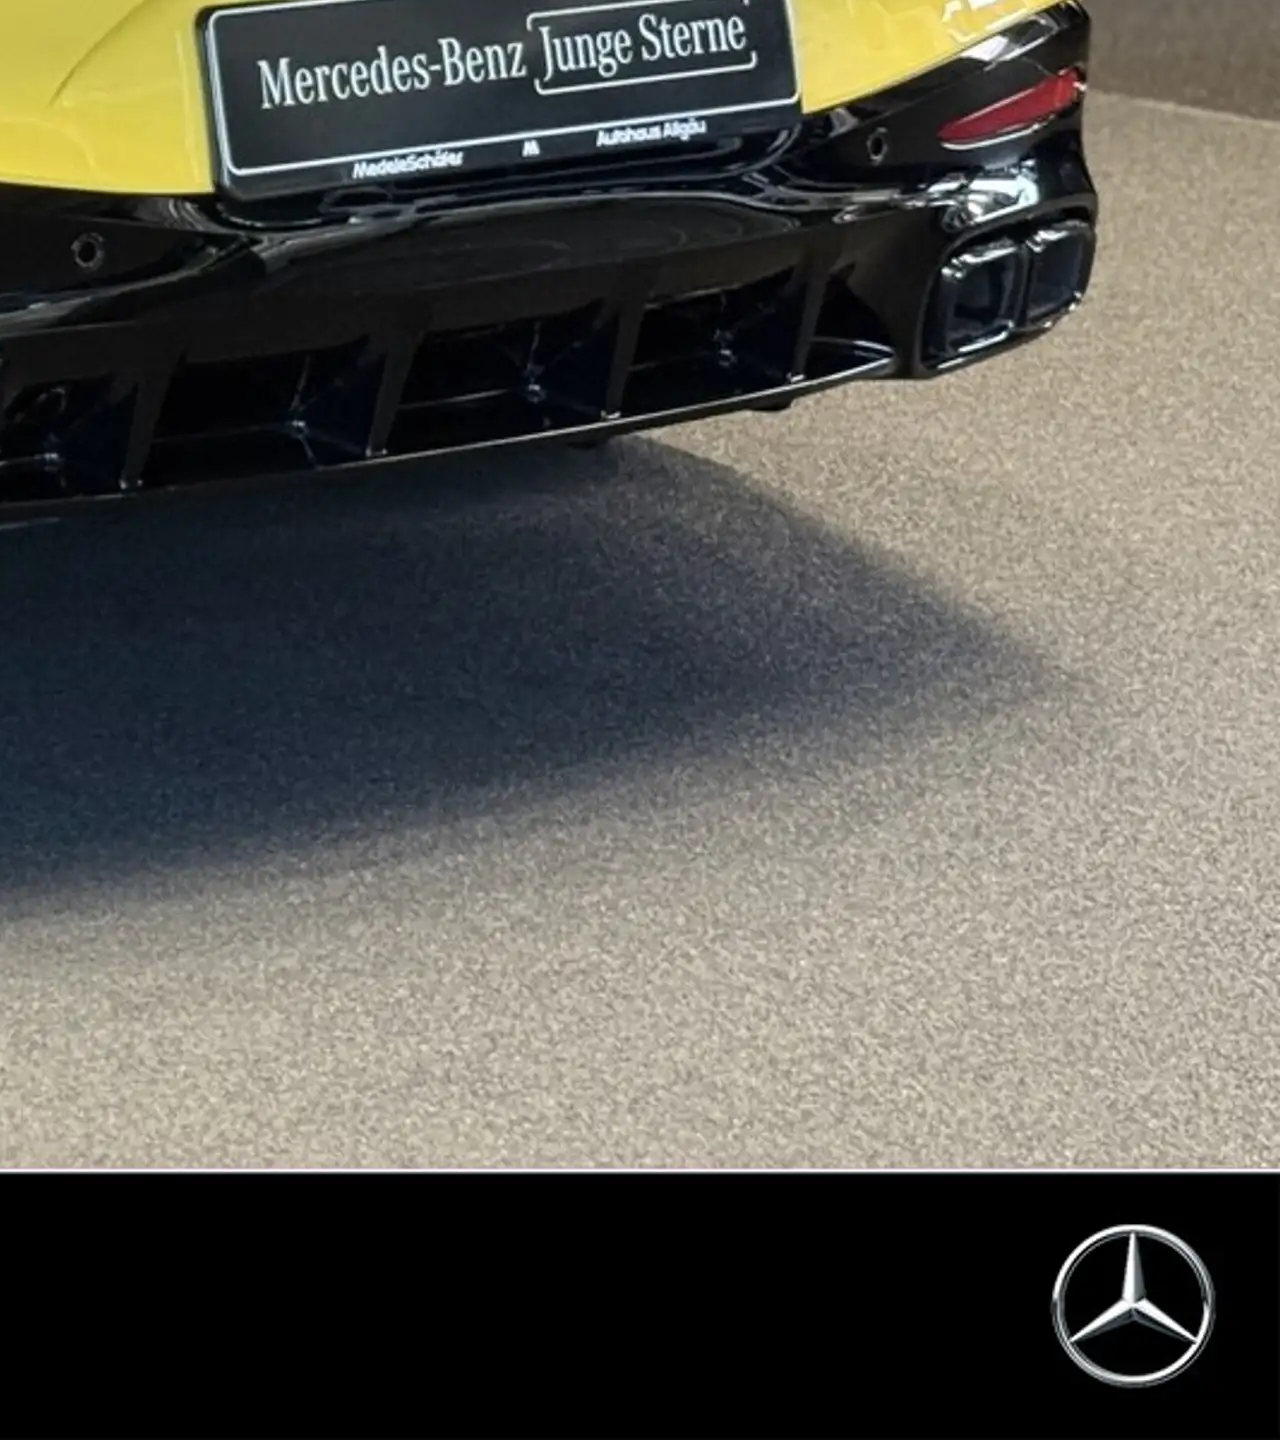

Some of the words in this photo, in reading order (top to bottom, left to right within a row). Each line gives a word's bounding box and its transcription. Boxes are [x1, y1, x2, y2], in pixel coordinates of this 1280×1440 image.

[257, 37, 527, 110] Mercedes-Benz
[538, 23, 633, 81] Junge
[638, 13, 748, 61] Sterne
[595, 125, 662, 148] Autohaus
[662, 117, 707, 142] Allgäu
[352, 148, 464, 180] MedeleSchäfer
